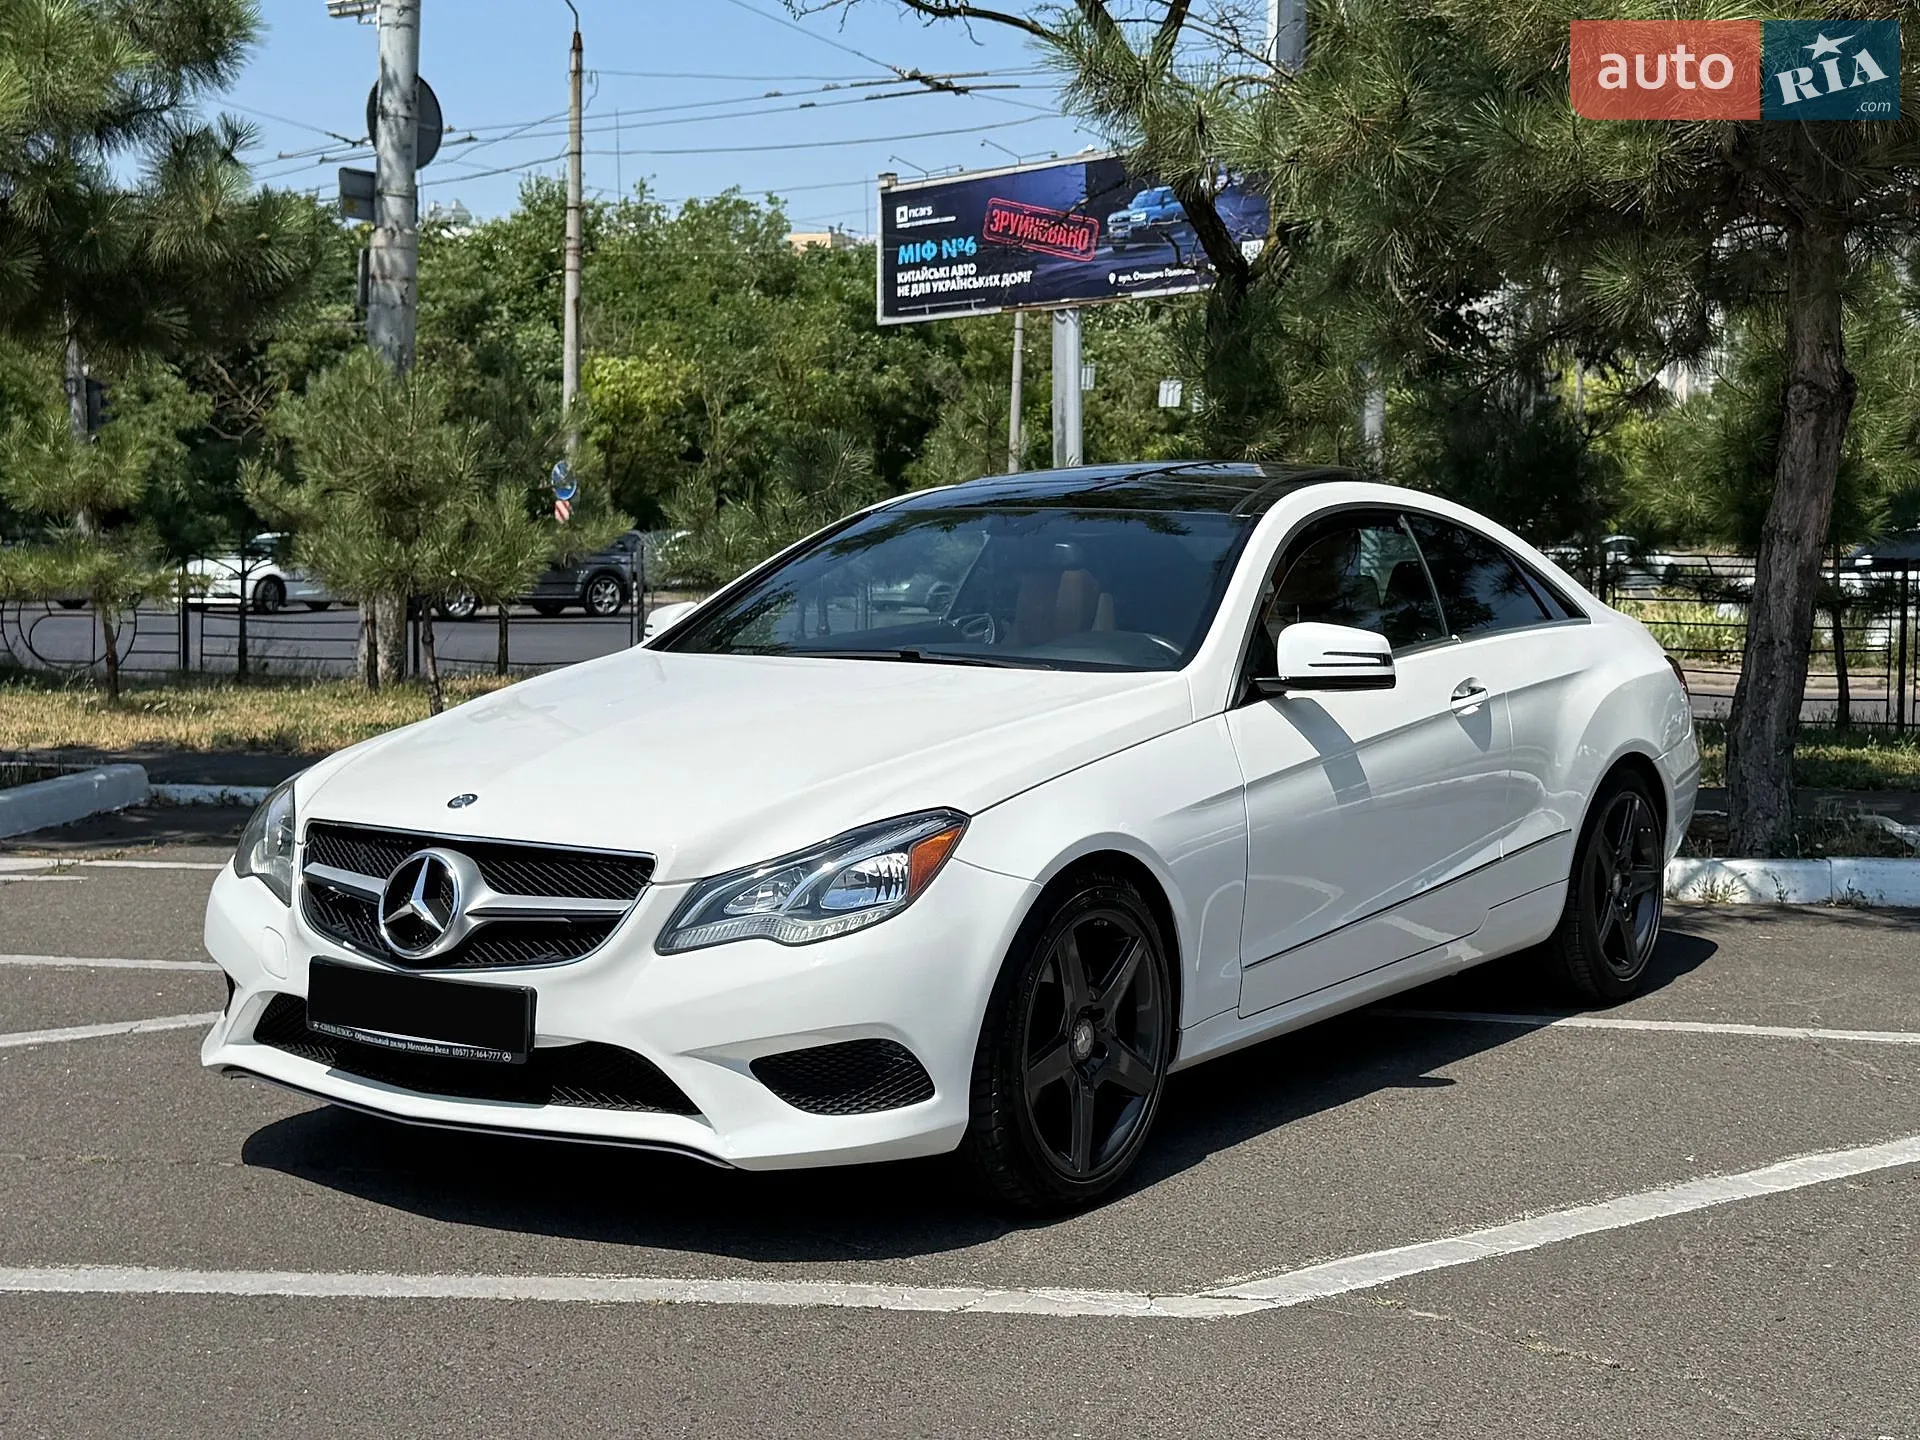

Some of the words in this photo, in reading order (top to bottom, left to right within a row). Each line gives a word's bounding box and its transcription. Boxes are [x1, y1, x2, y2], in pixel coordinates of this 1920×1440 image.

[898, 240, 938, 265] МІФ
[942, 236, 977, 259] №6
[897, 266, 950, 284] КИТАЙСЬКІ
[951, 263, 977, 277] АВТО
[897, 284, 910, 297] НЕ
[911, 282, 931, 297] ДЛЯ
[932, 275, 1000, 293] УКРАЇНСЬКИХ
[1001, 270, 1033, 287] ДОРІГ
[452, 1047, 469, 1057] (057)
